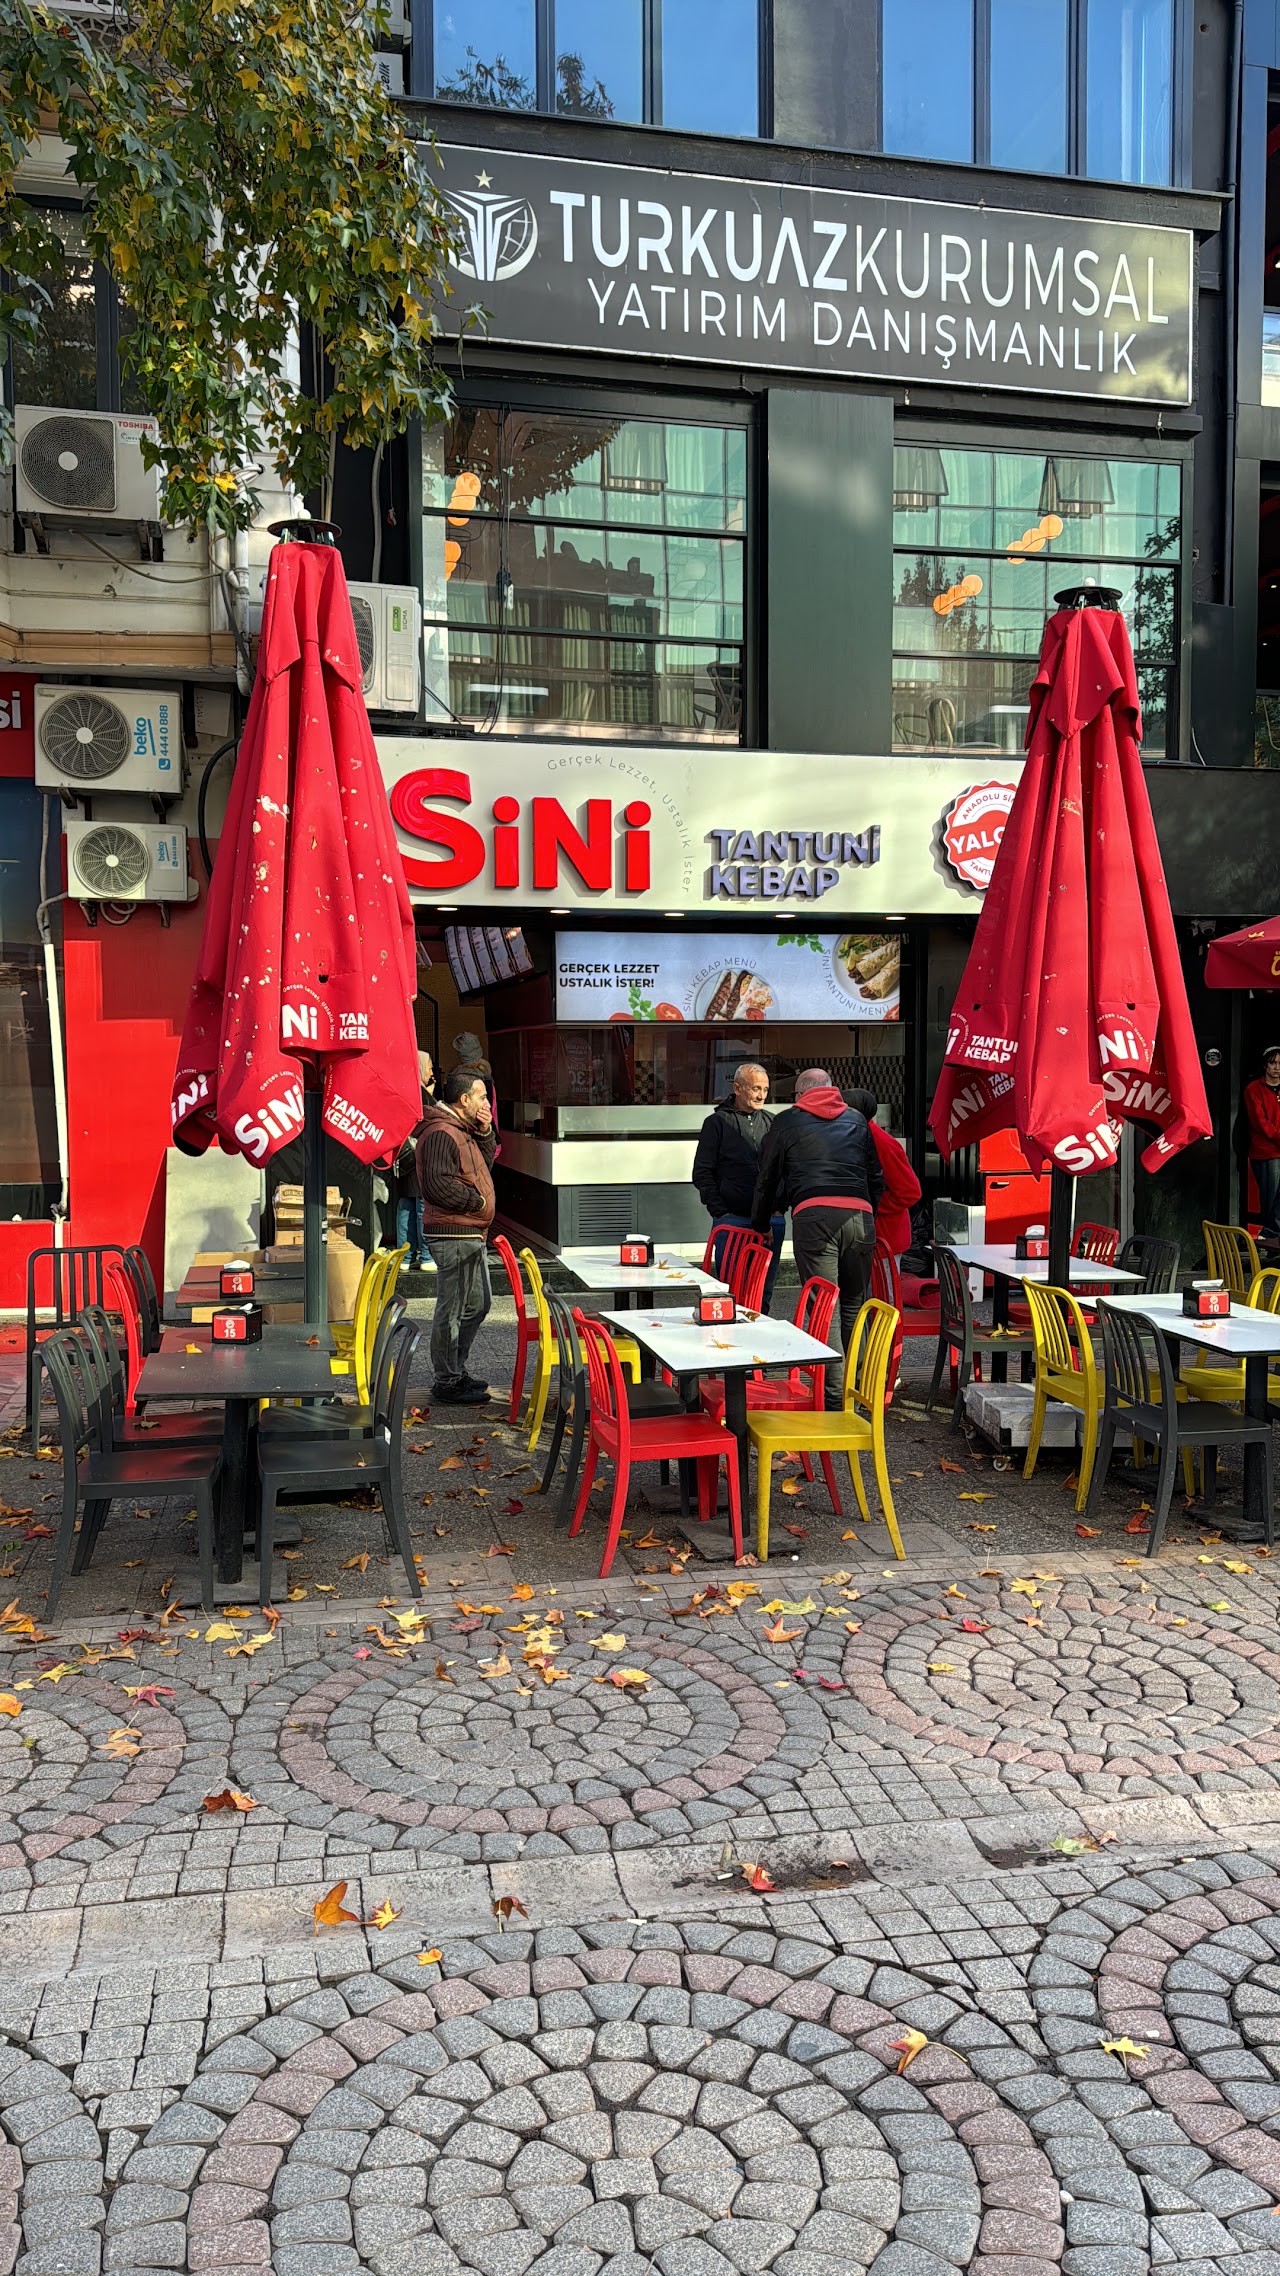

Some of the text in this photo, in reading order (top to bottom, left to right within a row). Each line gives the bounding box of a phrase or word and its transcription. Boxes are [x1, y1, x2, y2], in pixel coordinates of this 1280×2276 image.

[587, 278, 1137, 376] YATIRIM DANIŞMANLIK
[118, 421, 154, 430] TOSHIBA
[159, 705, 169, 726] 888
[134, 717, 147, 755] beko
[159, 736, 169, 756] 444
[547, 754, 602, 770] Gerçek
[609, 758, 657, 794] Lezzet,
[962, 793, 1000, 820] ANADOLU
[157, 841, 165, 861] beko
[711, 825, 881, 863] TANTUNİ
[711, 865, 840, 896] KEBAP
[559, 963, 660, 976] GERÇEK LEZZET
[691, 960, 720, 988] KEBAP
[559, 975, 655, 988] USTALIK İSTER!
[964, 1046, 1012, 1064] KEBAP
[324, 1106, 366, 1142] KEBAP
[630, 1254, 639, 1262] 12
[231, 1283, 243, 1292] 14
[711, 1310, 723, 1319] 13
[1209, 1304, 1220, 1313] 10
[224, 1328, 236, 1338] 15
